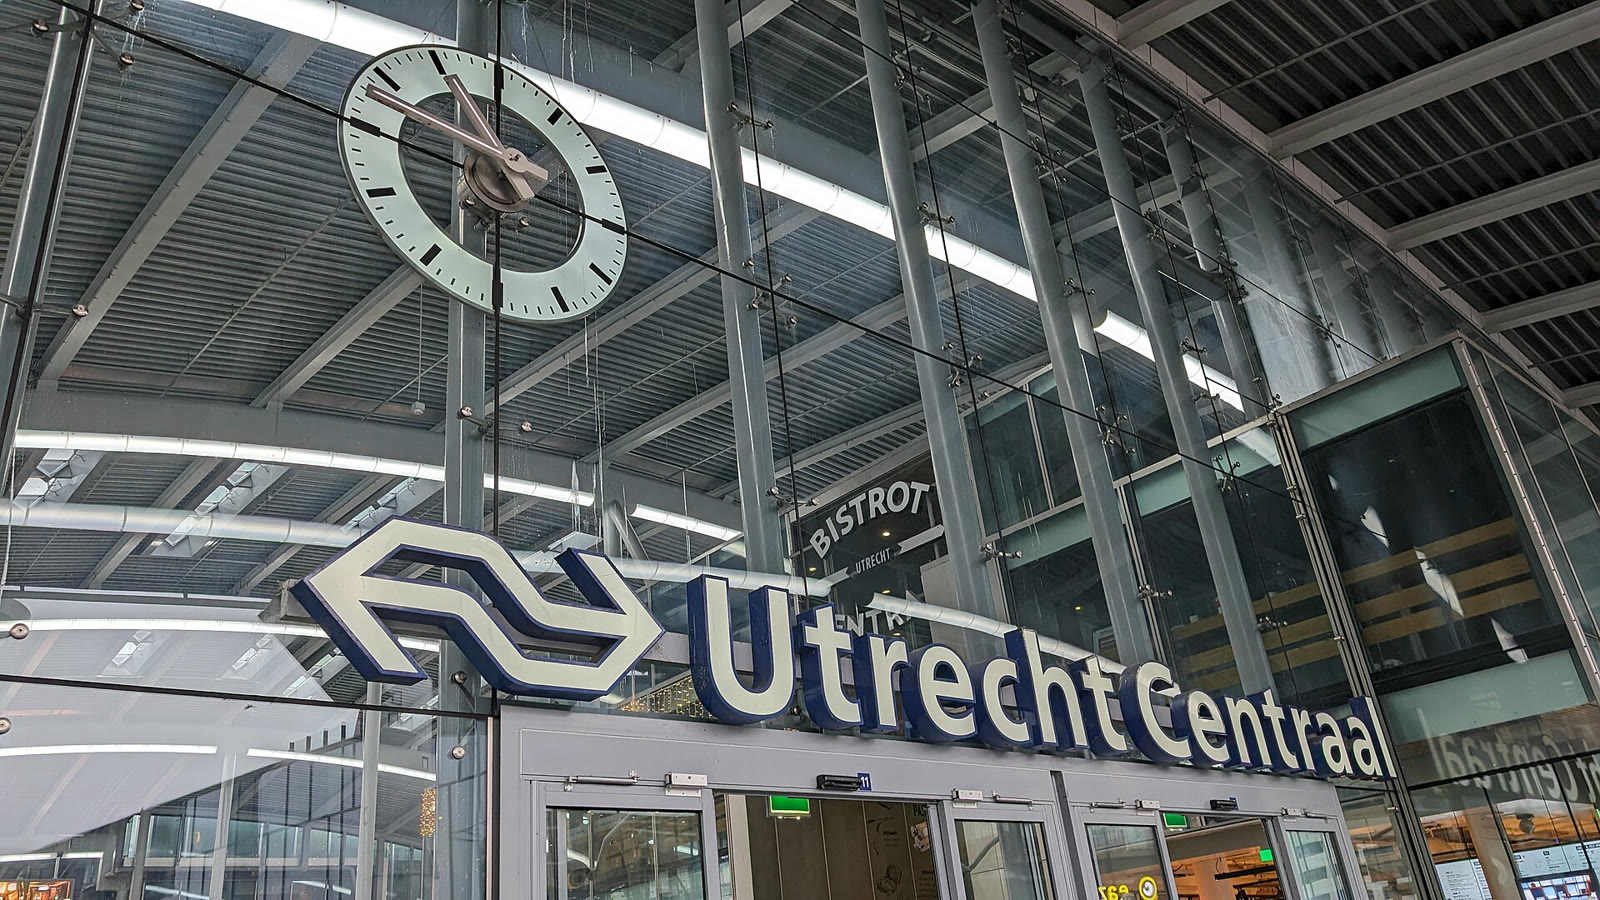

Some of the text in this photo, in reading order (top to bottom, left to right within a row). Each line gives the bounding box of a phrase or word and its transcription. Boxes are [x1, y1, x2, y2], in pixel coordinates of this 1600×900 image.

[809, 480, 930, 559] BISTROT
[855, 546, 891, 574] UTRECHT
[703, 576, 1128, 752] Utrecht
[1135, 660, 1397, 779] Centraal
[860, 776, 870, 788] 11
